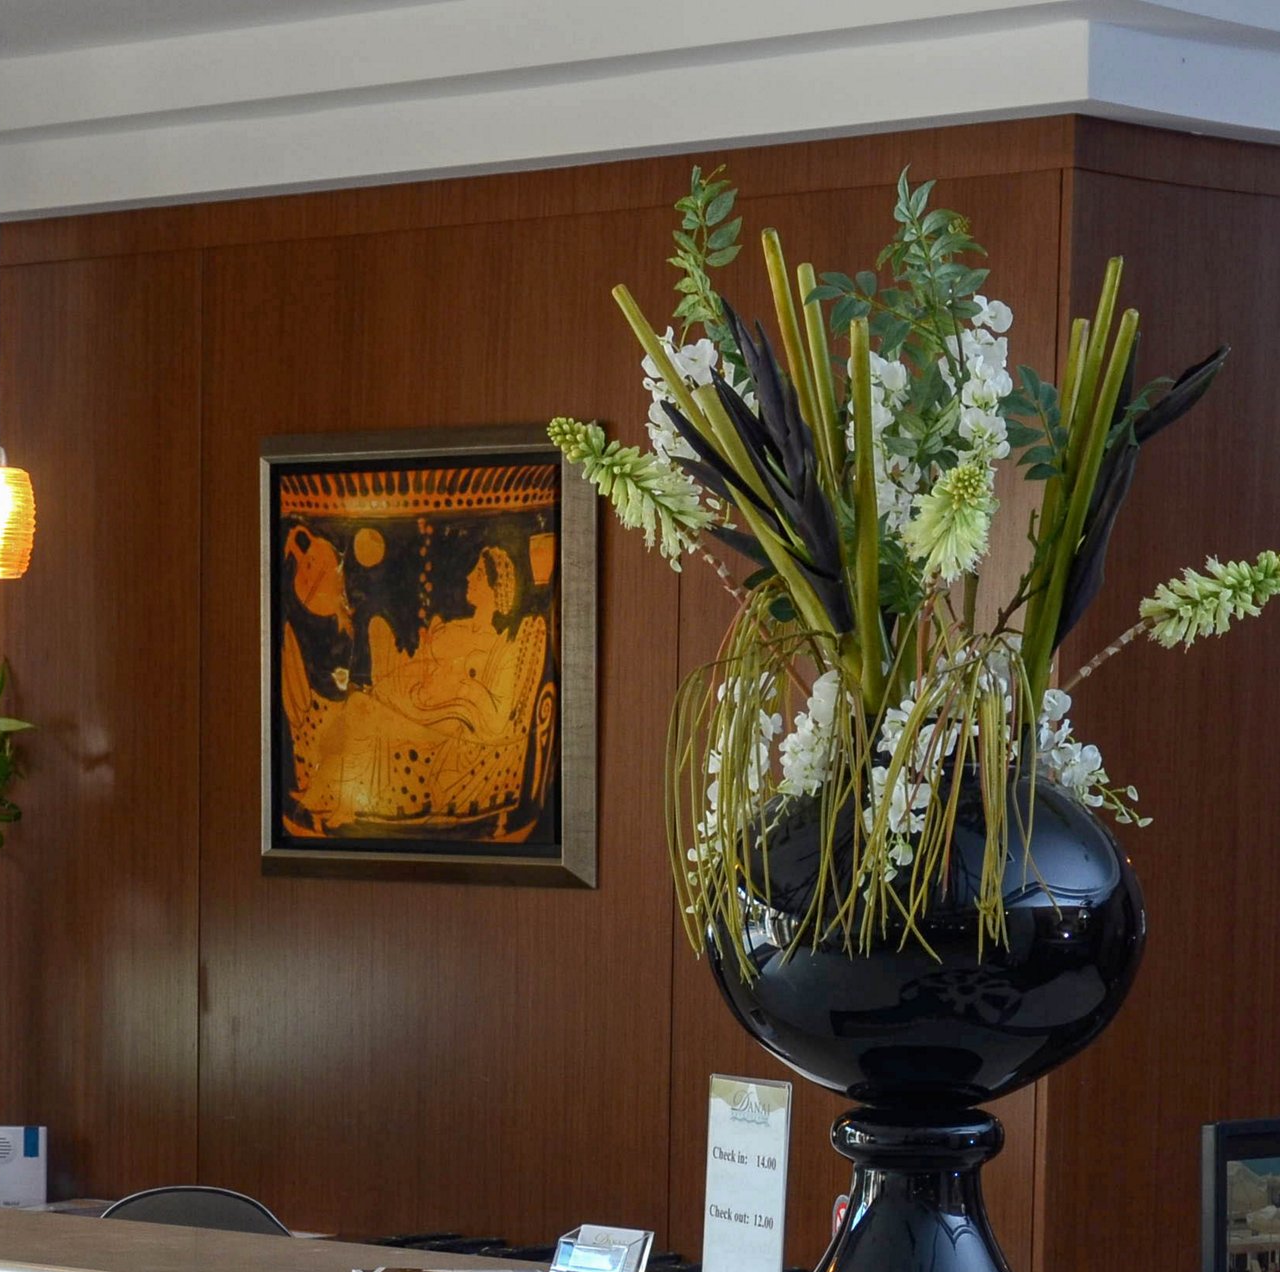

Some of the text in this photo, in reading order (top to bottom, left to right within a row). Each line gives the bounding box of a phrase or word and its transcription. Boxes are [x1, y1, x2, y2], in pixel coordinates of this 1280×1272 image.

[731, 1090, 770, 1116] DANAI
[713, 1146, 777, 1171] Check in: 14.00
[709, 1204, 774, 1230] Check out: 12.00
